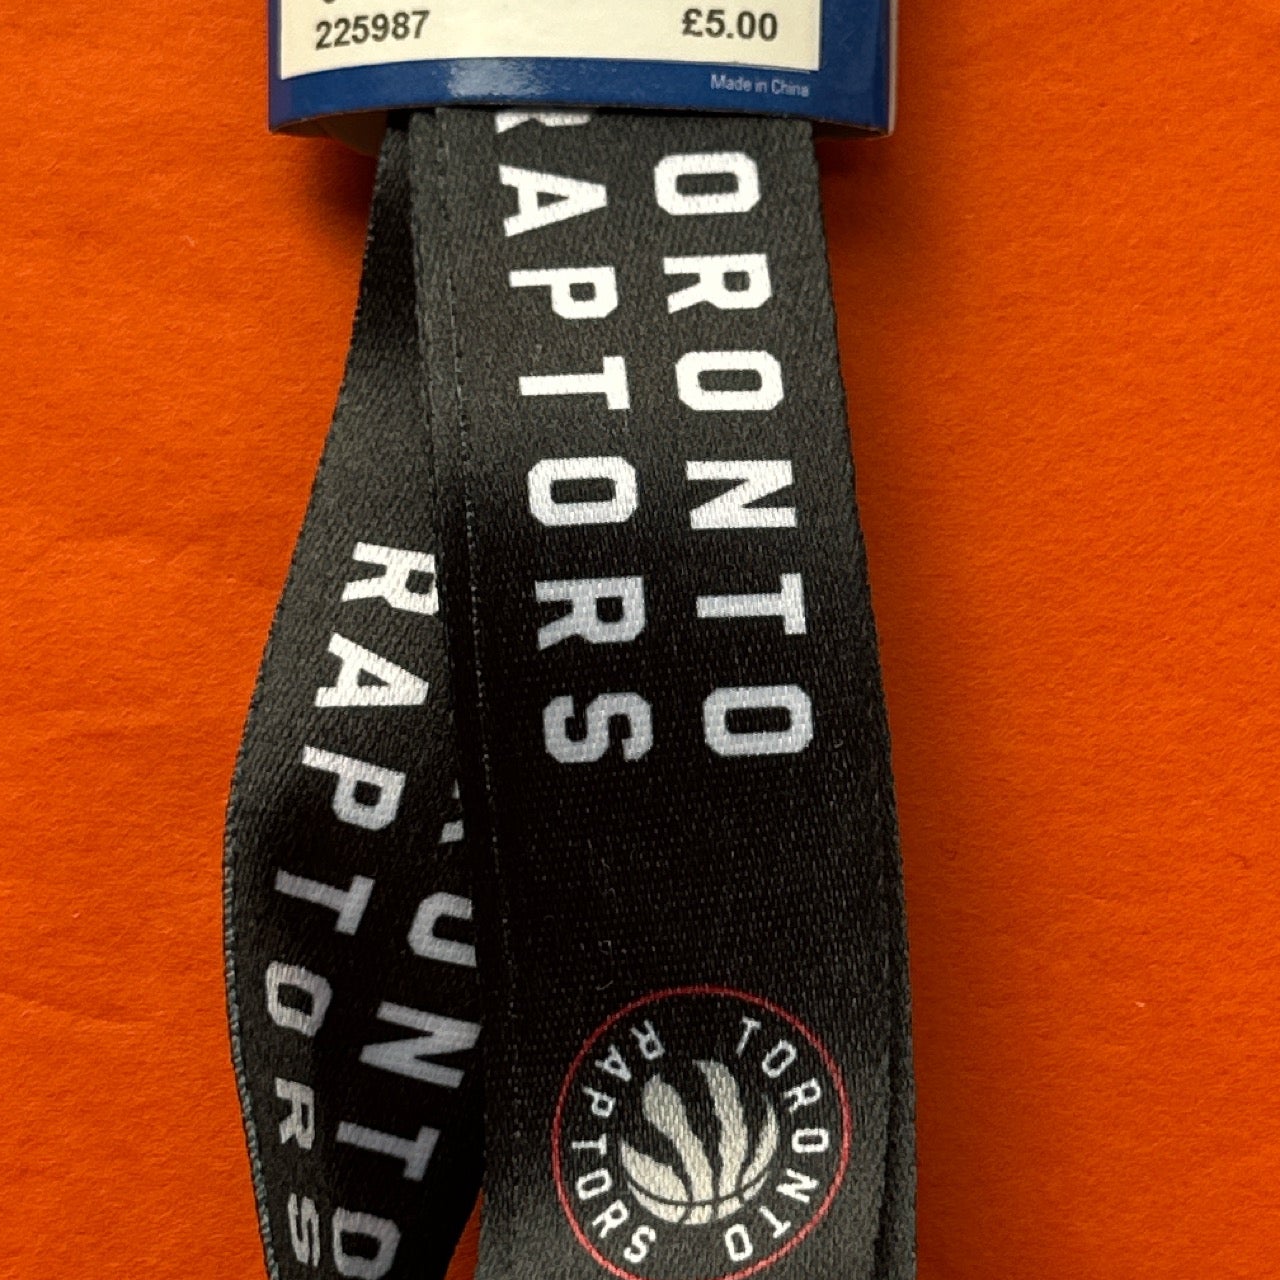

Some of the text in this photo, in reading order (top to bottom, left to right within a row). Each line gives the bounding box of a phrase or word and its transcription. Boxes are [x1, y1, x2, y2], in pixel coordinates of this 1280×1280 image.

[315, 9, 430, 50] 225987
[682, 8, 778, 41] £5.00
[710, 73, 809, 98] Made in China
[654, 152, 814, 758] ORONTO
[266, 541, 439, 1267] RAPTORS
[572, 1020, 665, 1263] RAPTORS
[724, 1016, 829, 1261] TORONTO
